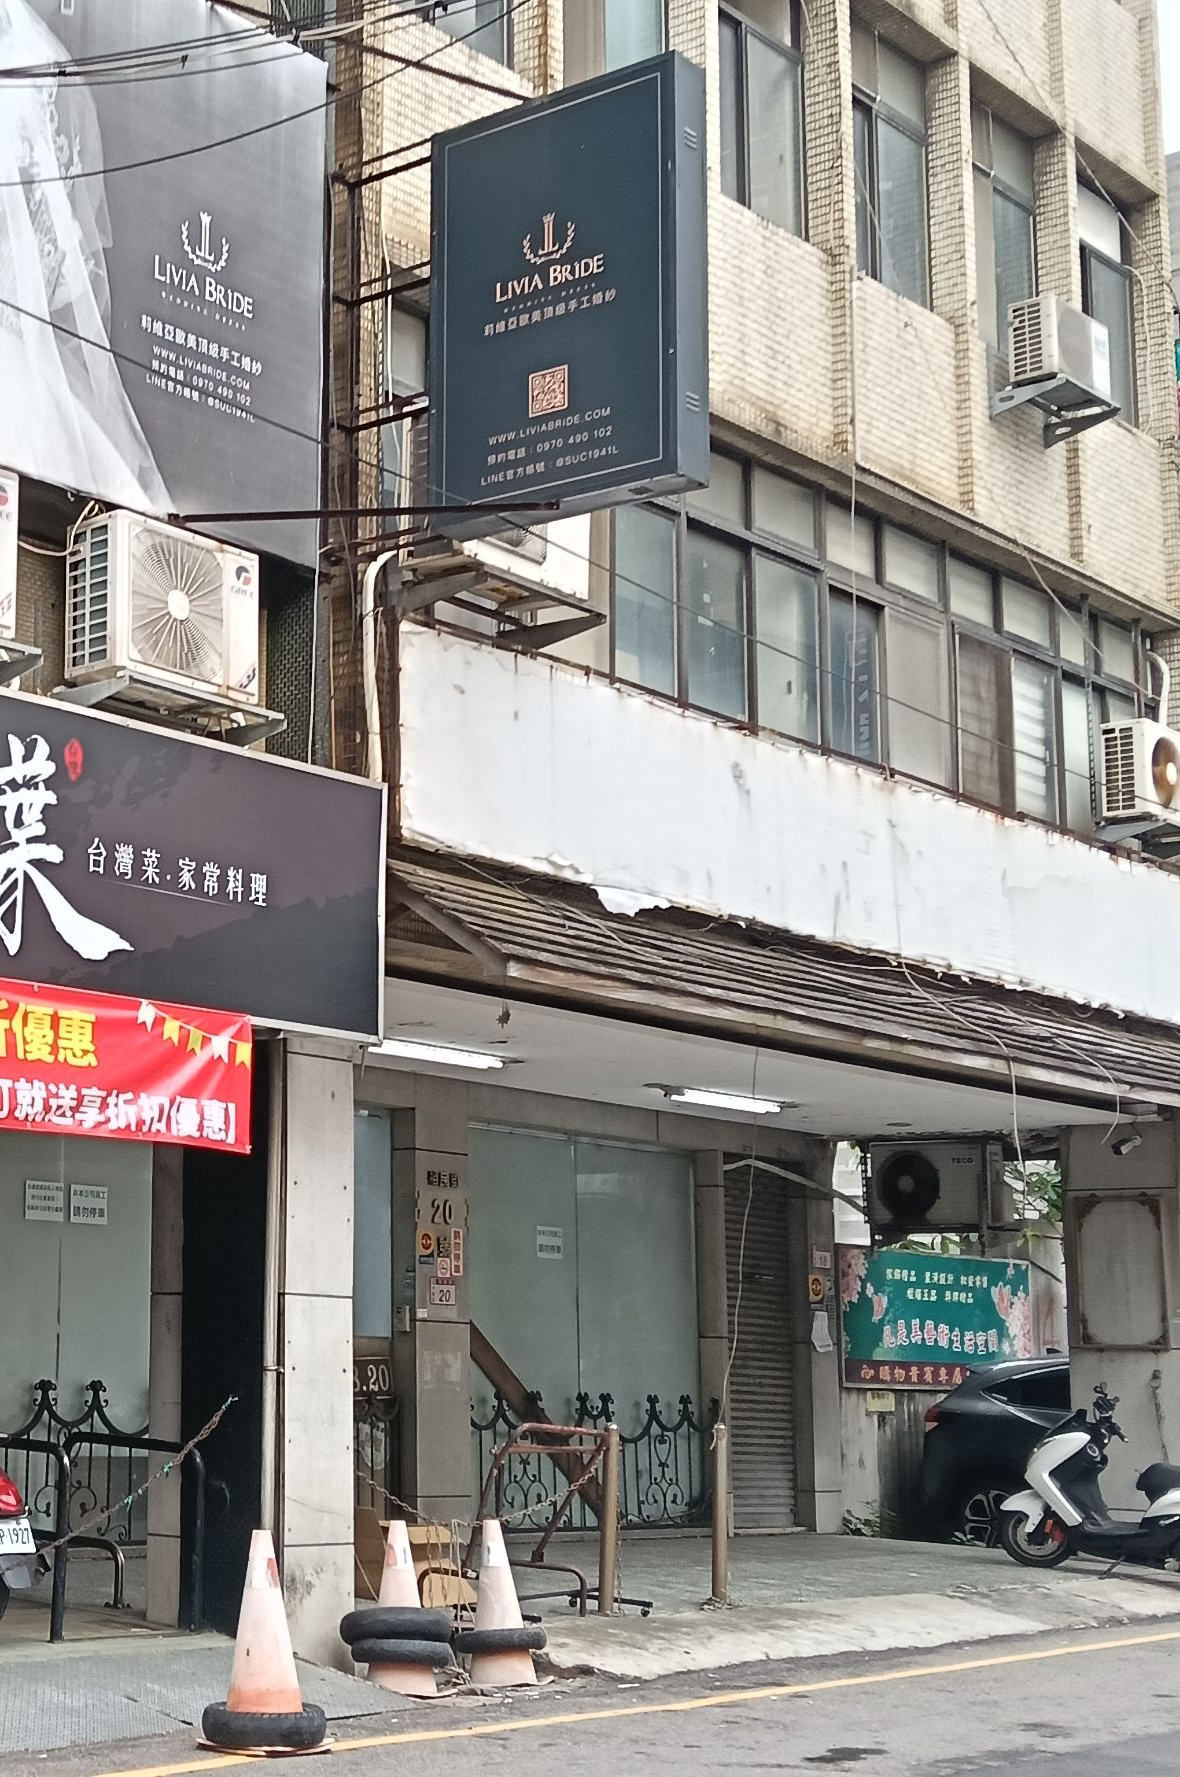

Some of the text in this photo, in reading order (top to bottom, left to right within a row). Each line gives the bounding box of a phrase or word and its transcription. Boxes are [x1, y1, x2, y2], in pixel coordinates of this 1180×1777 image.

[154, 254, 200, 297] LIVIA
[495, 273, 543, 303] LIVIA
[152, 344, 250, 391] WWW.LIVIABRIDE.COM
[488, 406, 611, 445] WWW.LIVIABRIDE.COM
[536, 438, 564, 453] 0970
[568, 431, 589, 444] 490
[593, 425, 613, 439] 102
[430, 1198, 452, 1226] 20
[438, 1289, 451, 1303] 20
